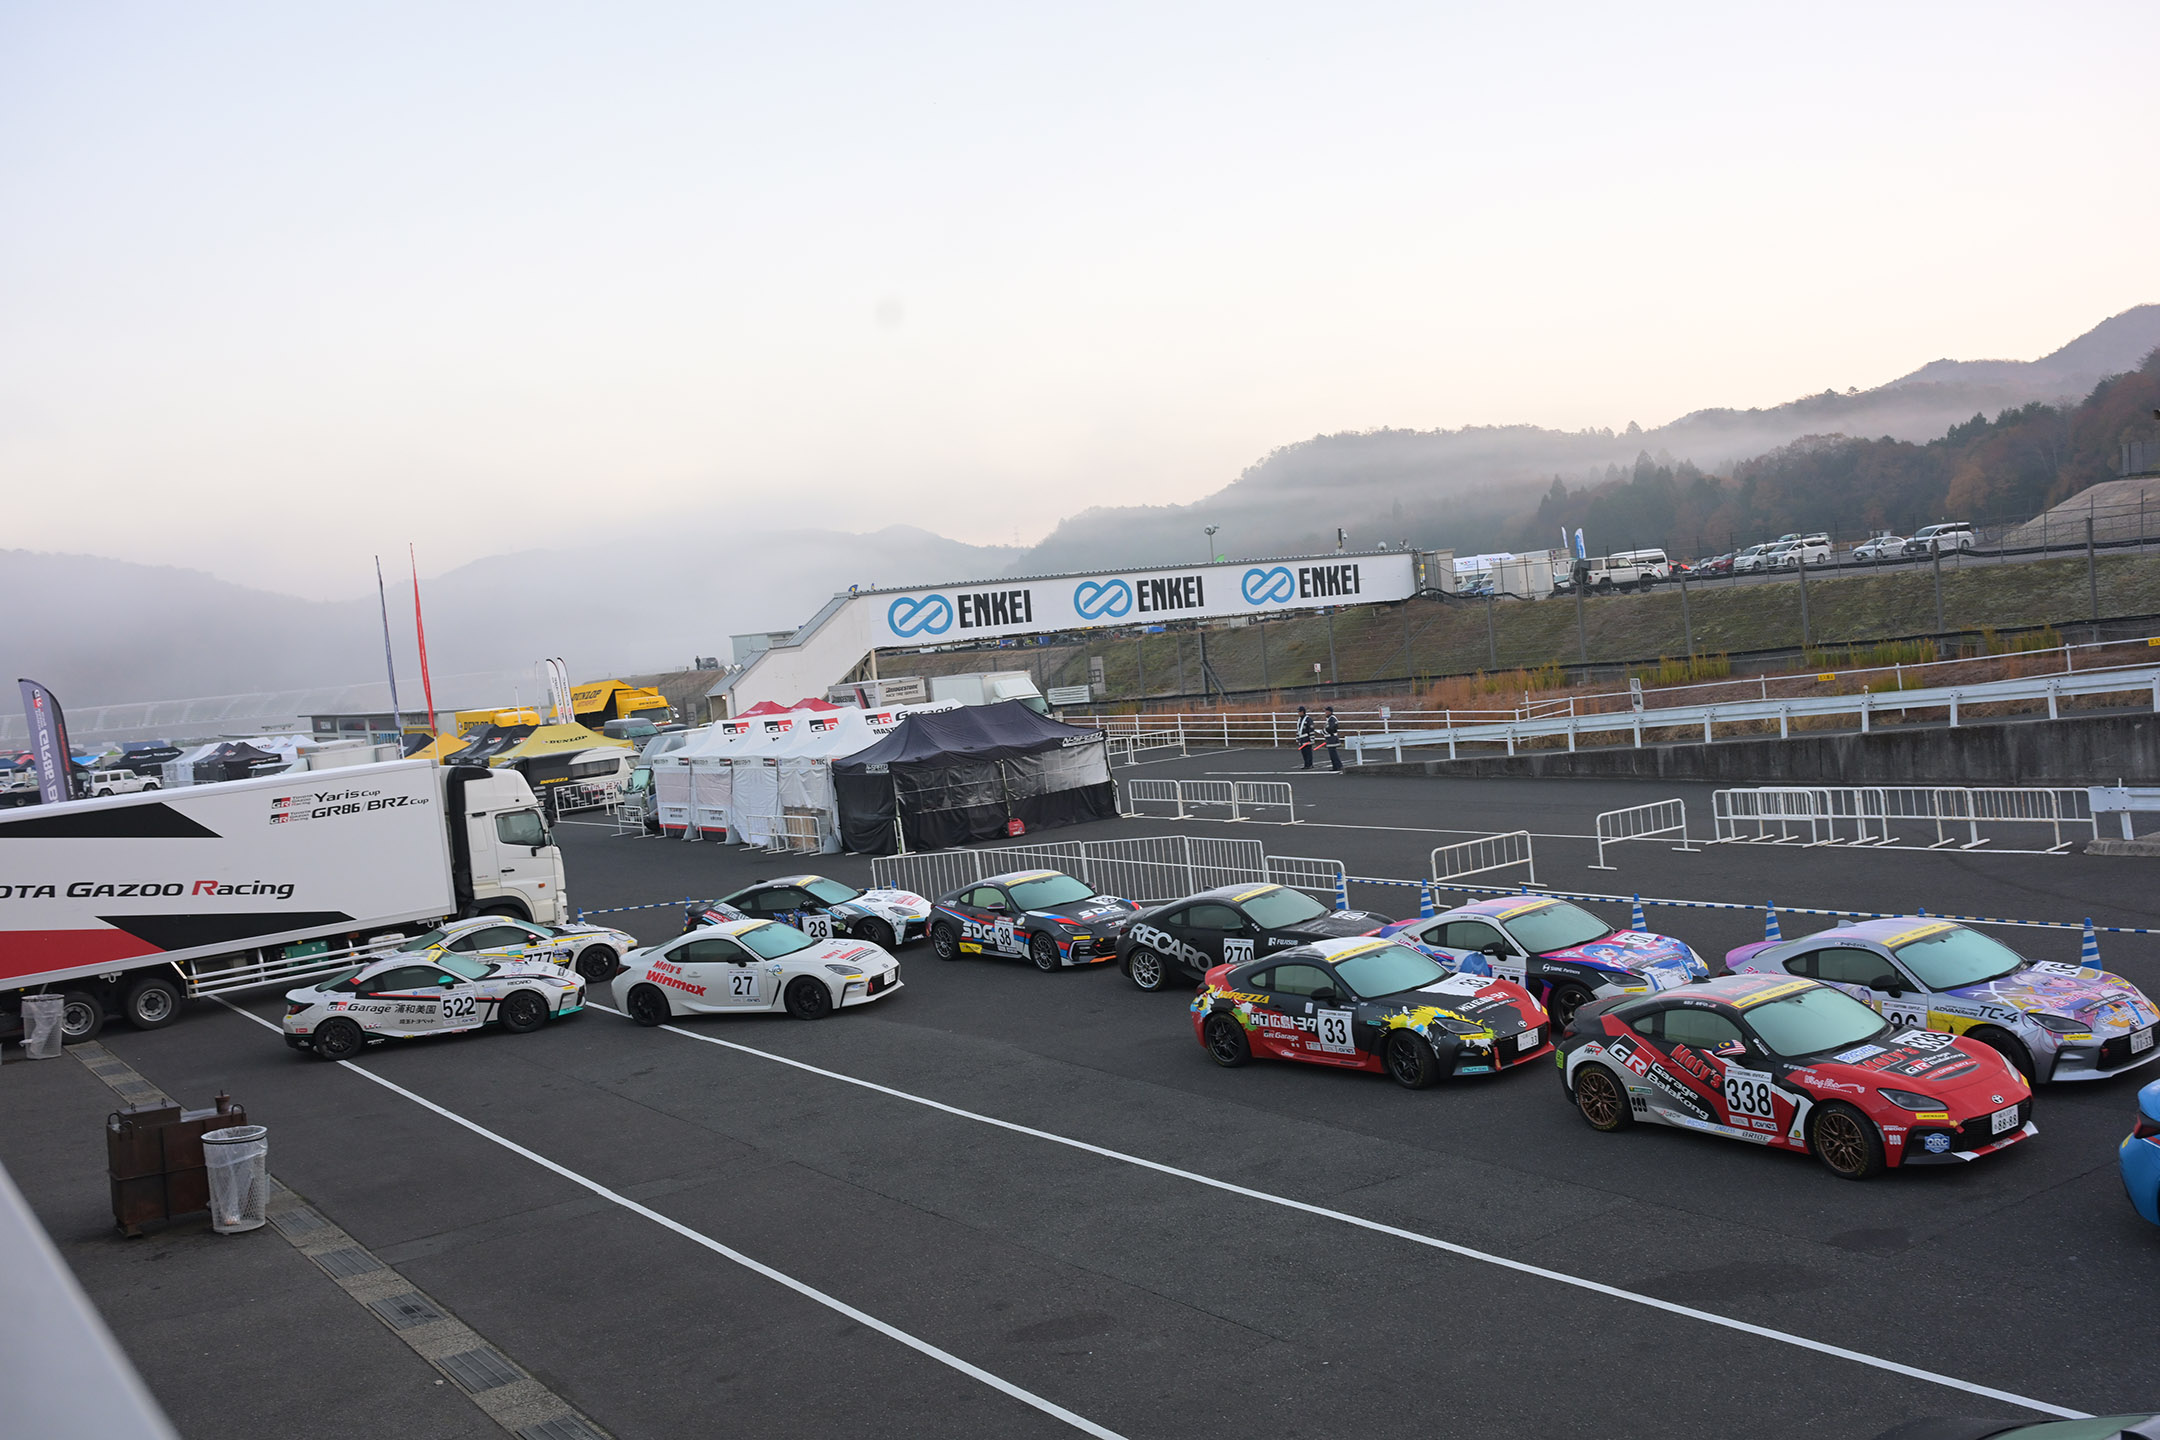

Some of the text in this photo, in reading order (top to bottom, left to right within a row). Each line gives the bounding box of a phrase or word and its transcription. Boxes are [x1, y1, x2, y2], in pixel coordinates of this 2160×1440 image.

[1298, 564, 1361, 599] ENKEI
[1136, 575, 1205, 613] ENKEI
[957, 589, 1033, 629] ENKEI
[571, 689, 603, 702] DUNLOP
[886, 684, 918, 693] BRIDGESTONE
[810, 723, 840, 733] GR
[866, 715, 894, 725] GR
[723, 726, 750, 735] GR
[765, 725, 793, 734] GR
[549, 735, 588, 744] DUNLOP
[1063, 731, 1104, 747] N-SPEED
[314, 790, 360, 803] Yaris
[66, 882, 184, 898] GAZOO
[191, 880, 295, 900] Racing
[1079, 905, 1124, 920] SDG
[808, 920, 828, 939] 28
[998, 926, 1012, 947] 38
[1129, 922, 1214, 973] RECARO
[1224, 945, 1254, 964] 270
[653, 960, 682, 974] Moty's
[507, 979, 532, 987] RECARO
[645, 970, 707, 997] Winmax
[732, 976, 753, 995] 27
[328, 1003, 347, 1012] GR
[347, 1003, 392, 1015] Garage
[443, 997, 476, 1019] 522
[1980, 1005, 2019, 1023] TC-4
[1270, 1015, 1318, 1032] 広島トヨタ
[1324, 1018, 1346, 1045] 33
[1275, 1031, 1299, 1041] Garage
[1904, 1033, 1954, 1051] 338
[1608, 1043, 1648, 1076] GR
[1670, 1043, 1723, 1089] Moty's
[1855, 1046, 1921, 1072] Moty's
[1905, 1061, 1932, 1075] GR
[1651, 1062, 1699, 1101] Garage
[1646, 1072, 1710, 1121] Balakong
[1727, 1078, 1771, 1116] 338
[1741, 1131, 1769, 1141] BRIDE
[1926, 1138, 1949, 1147] ORC
